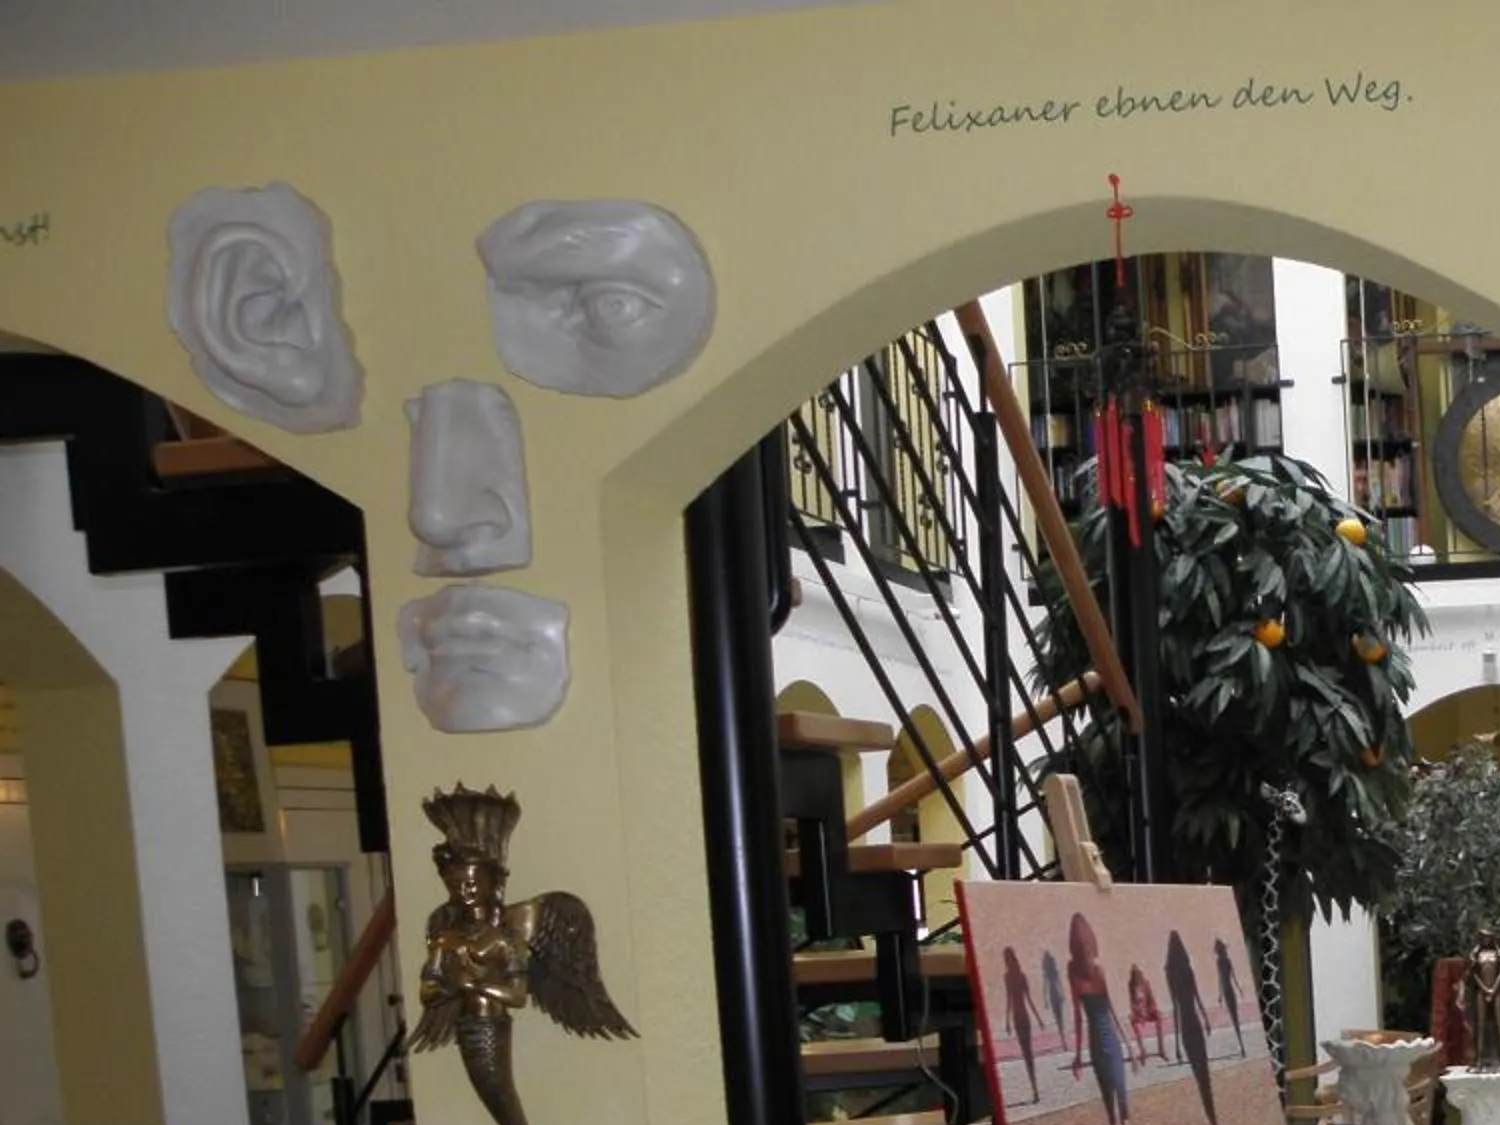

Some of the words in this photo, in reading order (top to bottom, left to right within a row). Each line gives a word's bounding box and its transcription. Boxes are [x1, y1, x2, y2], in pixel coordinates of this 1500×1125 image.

[889, 100, 1081, 137] Felixaner
[1096, 86, 1223, 119] ebnen
[1233, 78, 1313, 108] den
[1324, 72, 1415, 112] Weg.
